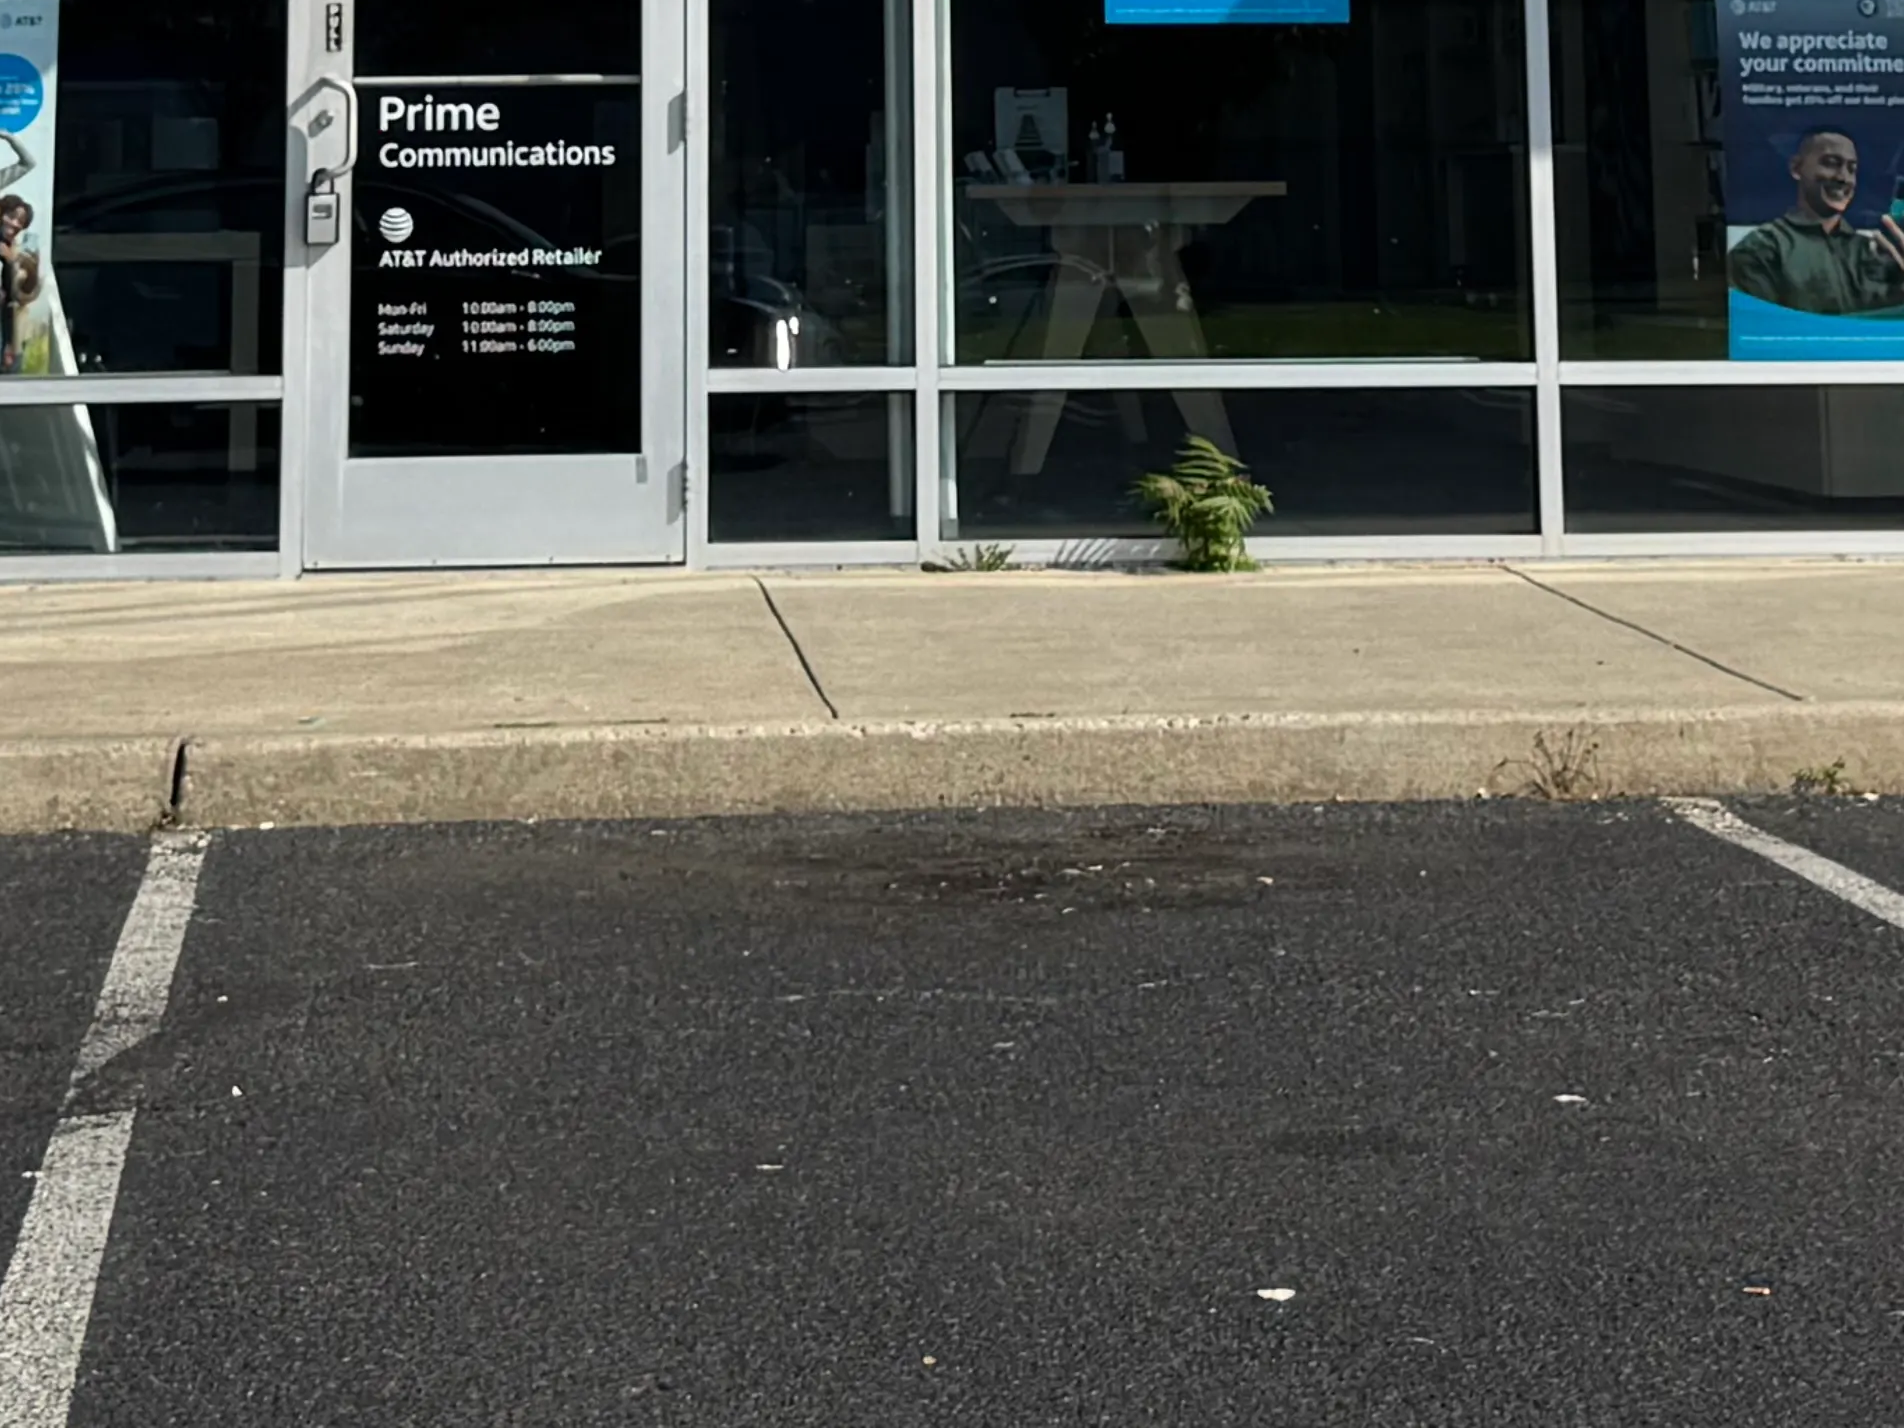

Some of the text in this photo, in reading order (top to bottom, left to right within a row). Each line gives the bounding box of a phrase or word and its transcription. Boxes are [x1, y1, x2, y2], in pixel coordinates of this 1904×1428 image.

[1738, 30, 1888, 54] We appreciate
[1740, 57, 1789, 77] your
[379, 94, 500, 132] Prime
[379, 140, 615, 168] Communications
[379, 247, 603, 267] AT&T Authorized Retailer
[378, 321, 434, 338] Saturday
[378, 340, 425, 357] Sunday
